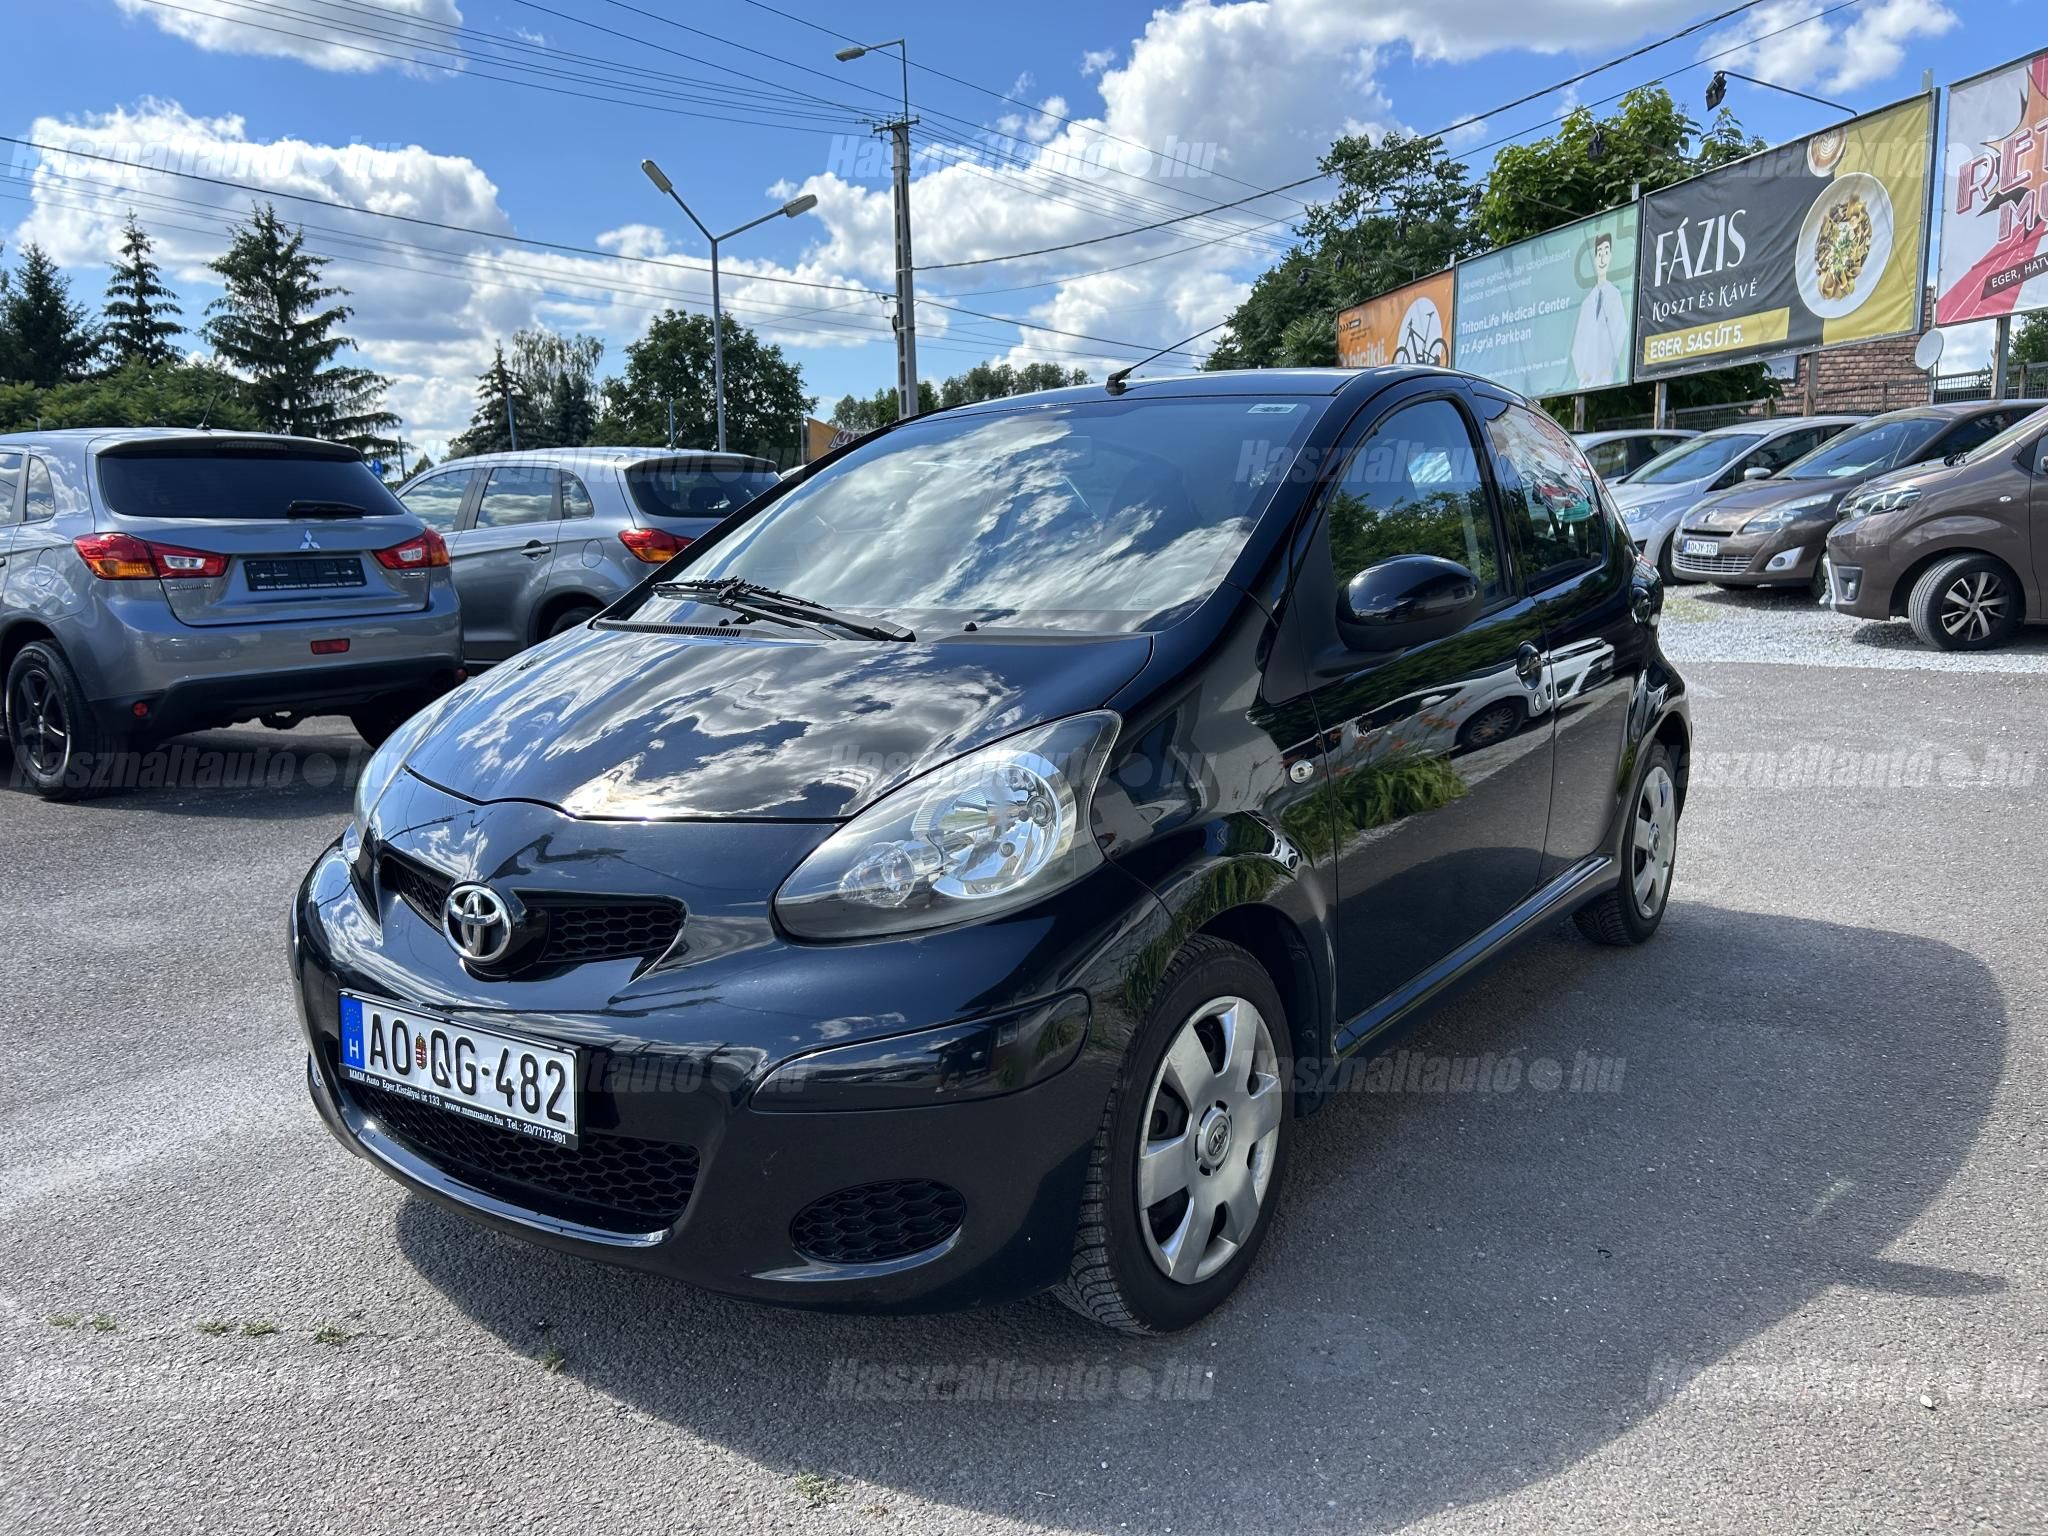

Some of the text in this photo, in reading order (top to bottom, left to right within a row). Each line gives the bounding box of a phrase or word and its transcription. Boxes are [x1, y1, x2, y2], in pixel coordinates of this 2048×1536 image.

[1654, 209, 1747, 287] FÁZIS
[1991, 269, 2021, 288] EGER,
[1461, 297, 1571, 335] TritonLife Medical Center
[1471, 336, 1493, 354] Agria
[1495, 327, 1532, 346] Parkban
[1650, 336, 1684, 360] EGER,
[1686, 330, 1713, 352] SAS
[1714, 323, 1732, 348] ÚT
[349, 1038, 360, 1059] H
[349, 1069, 365, 1082] MMM
[366, 1075, 380, 1087] Auto
[444, 1101, 504, 1126] www.mmmauto.hu
[523, 1122, 567, 1145] 20/7717-891
